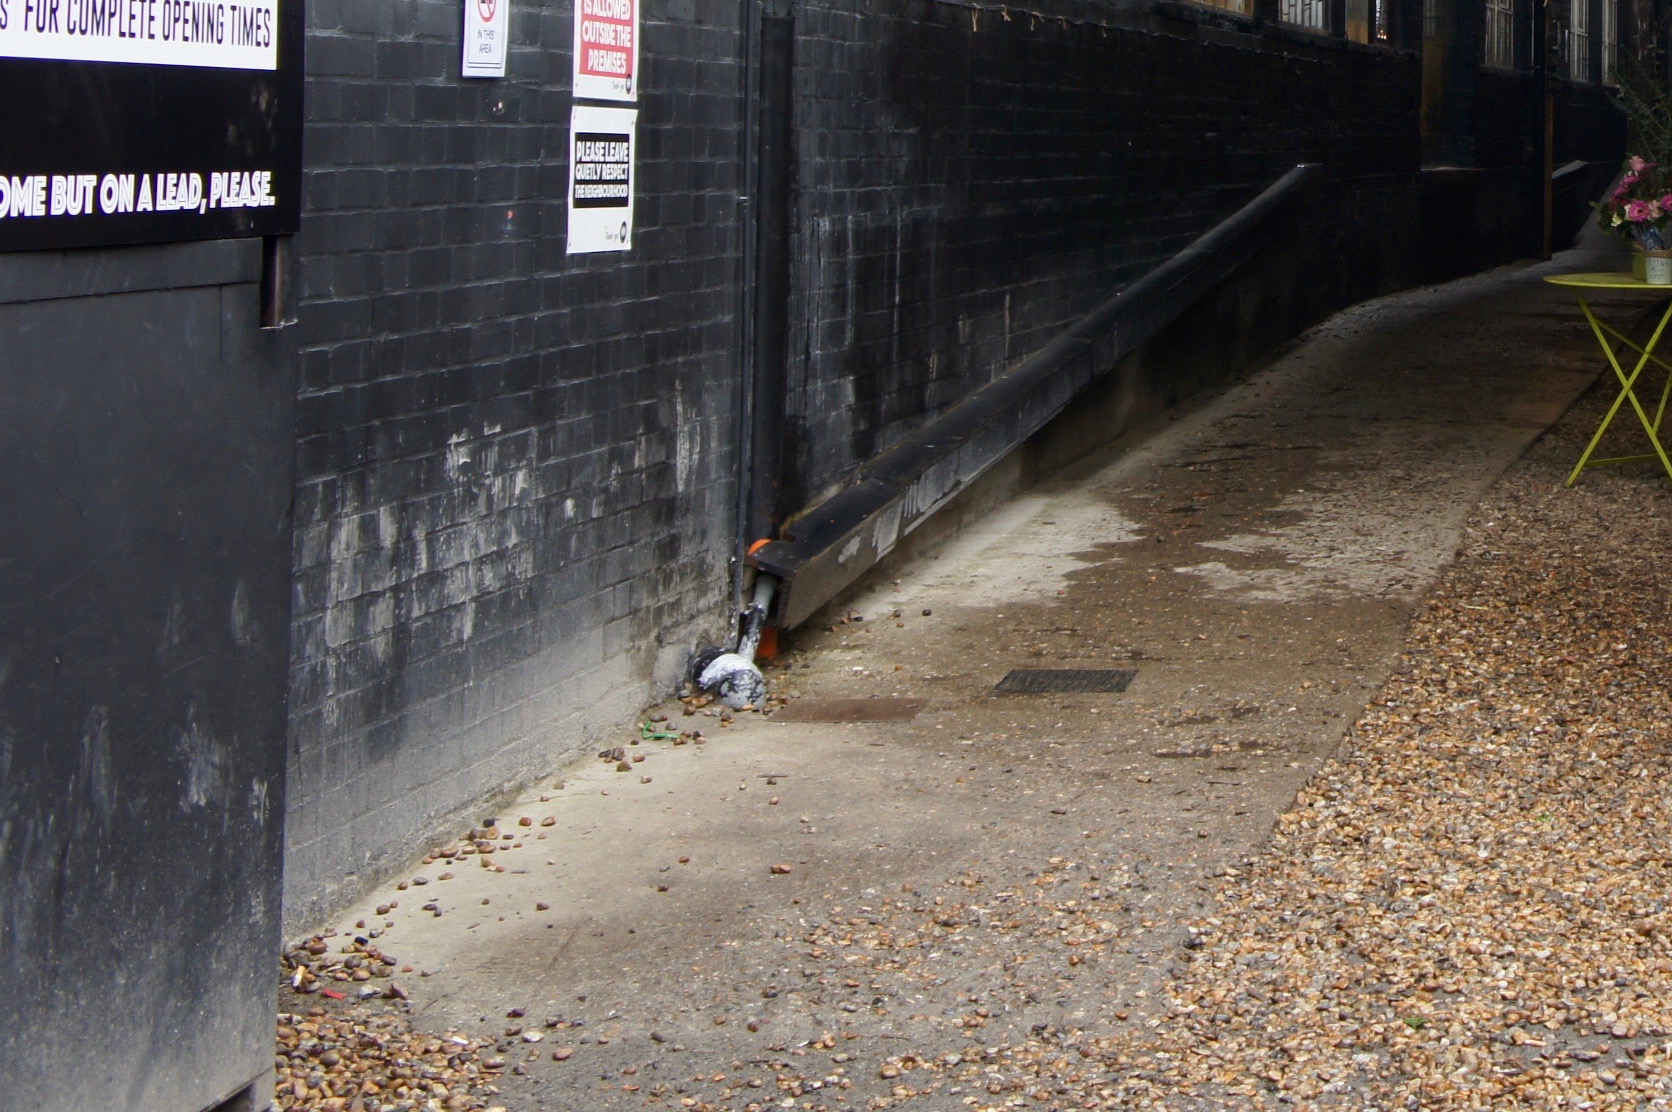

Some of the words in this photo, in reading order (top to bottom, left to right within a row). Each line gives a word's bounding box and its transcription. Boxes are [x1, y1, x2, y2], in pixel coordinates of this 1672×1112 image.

[231, 5, 271, 48] TIMES
[477, 29, 483, 40] IN
[483, 29, 495, 41] THIS
[582, 20, 616, 46] OUTSIDE
[616, 25, 632, 48] THE
[479, 43, 491, 53] AREA
[587, 48, 627, 74] PREMISES
[576, 141, 605, 162] PLEASE
[605, 141, 629, 162] LEAVE
[575, 163, 601, 180] QUIETLY
[601, 163, 629, 180] RESPECT
[50, 175, 97, 216] BUT
[100, 174, 135, 215] ON
[137, 173, 153, 212] A
[156, 172, 206, 214] LEAD,
[209, 171, 276, 209] PLEASE.
